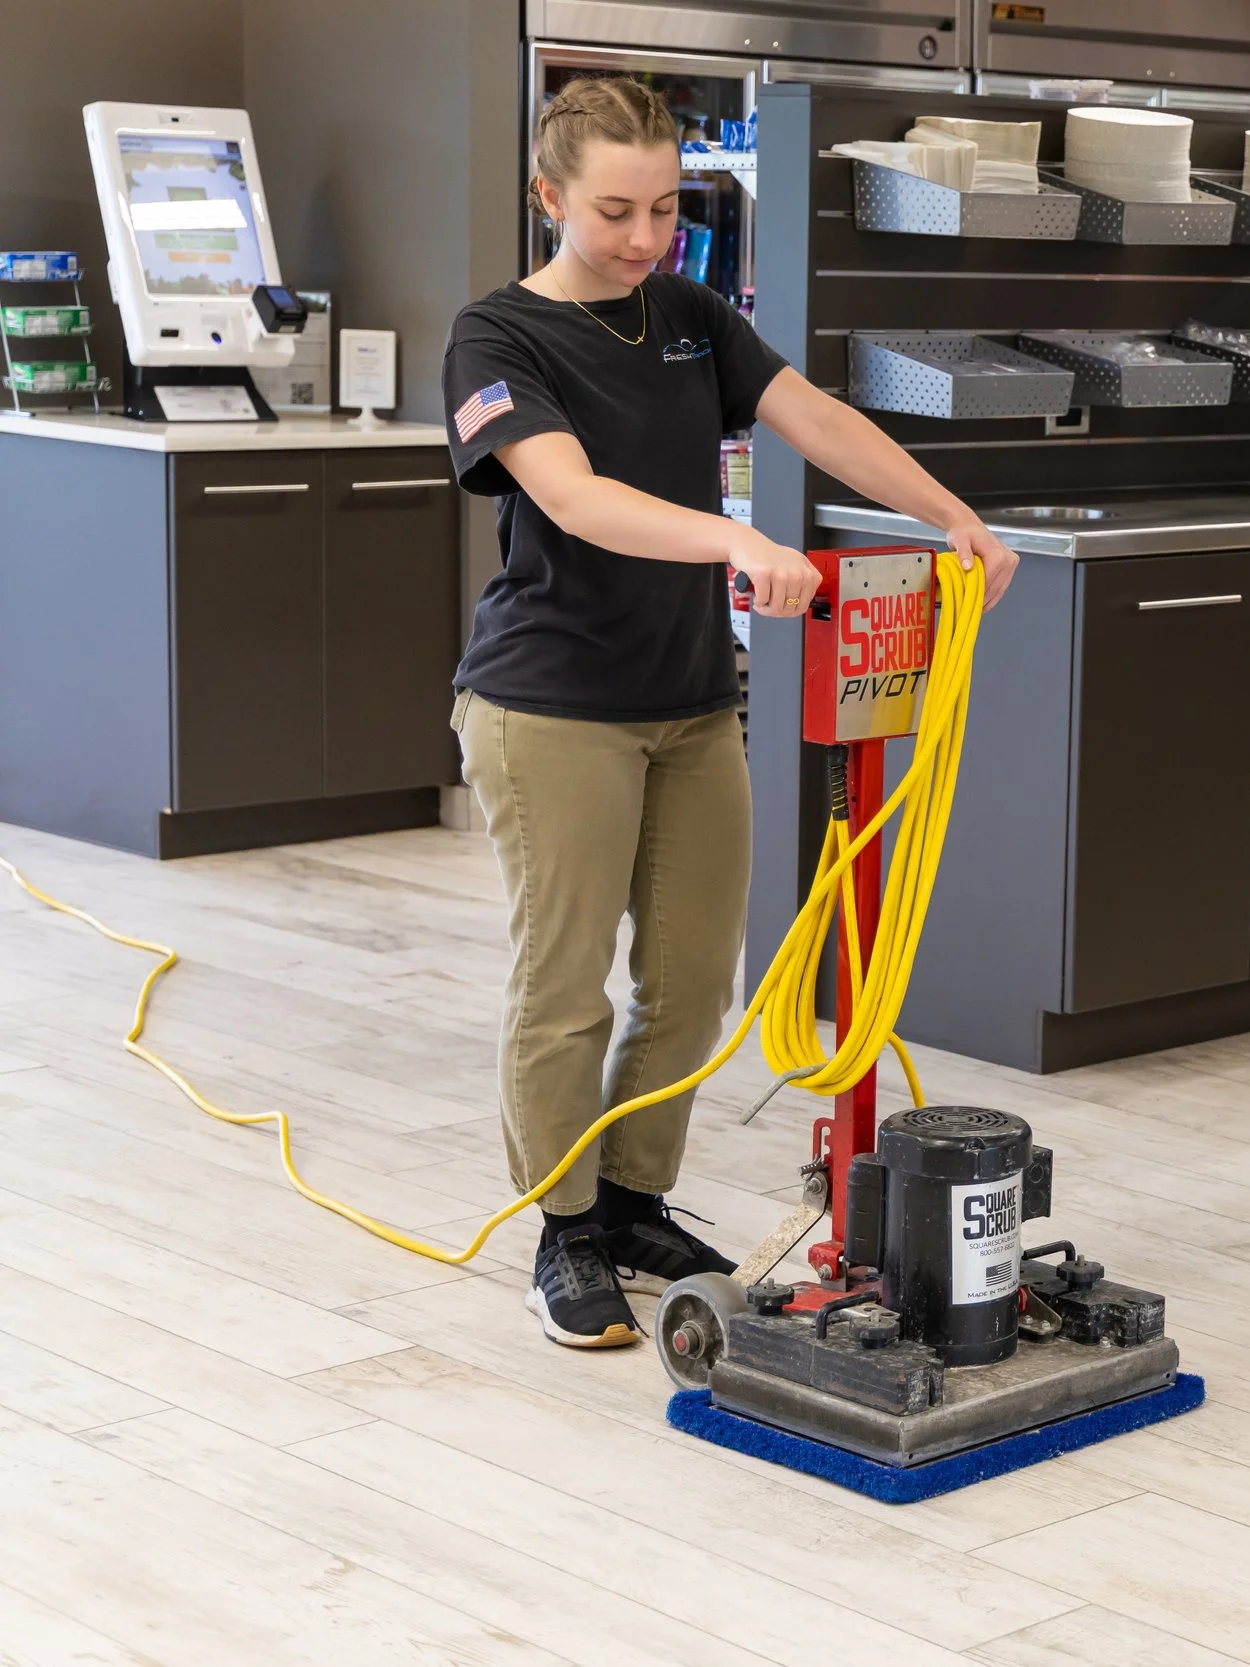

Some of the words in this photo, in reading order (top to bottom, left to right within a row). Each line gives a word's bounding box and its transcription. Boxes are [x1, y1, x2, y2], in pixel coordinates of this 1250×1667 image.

[840, 592, 927, 637] SQUARE
[840, 628, 927, 677] SCRUB
[840, 670, 927, 704] PIVOT
[963, 1186, 1016, 1217] SQUARE
[963, 1207, 1016, 1240] SCRUB
